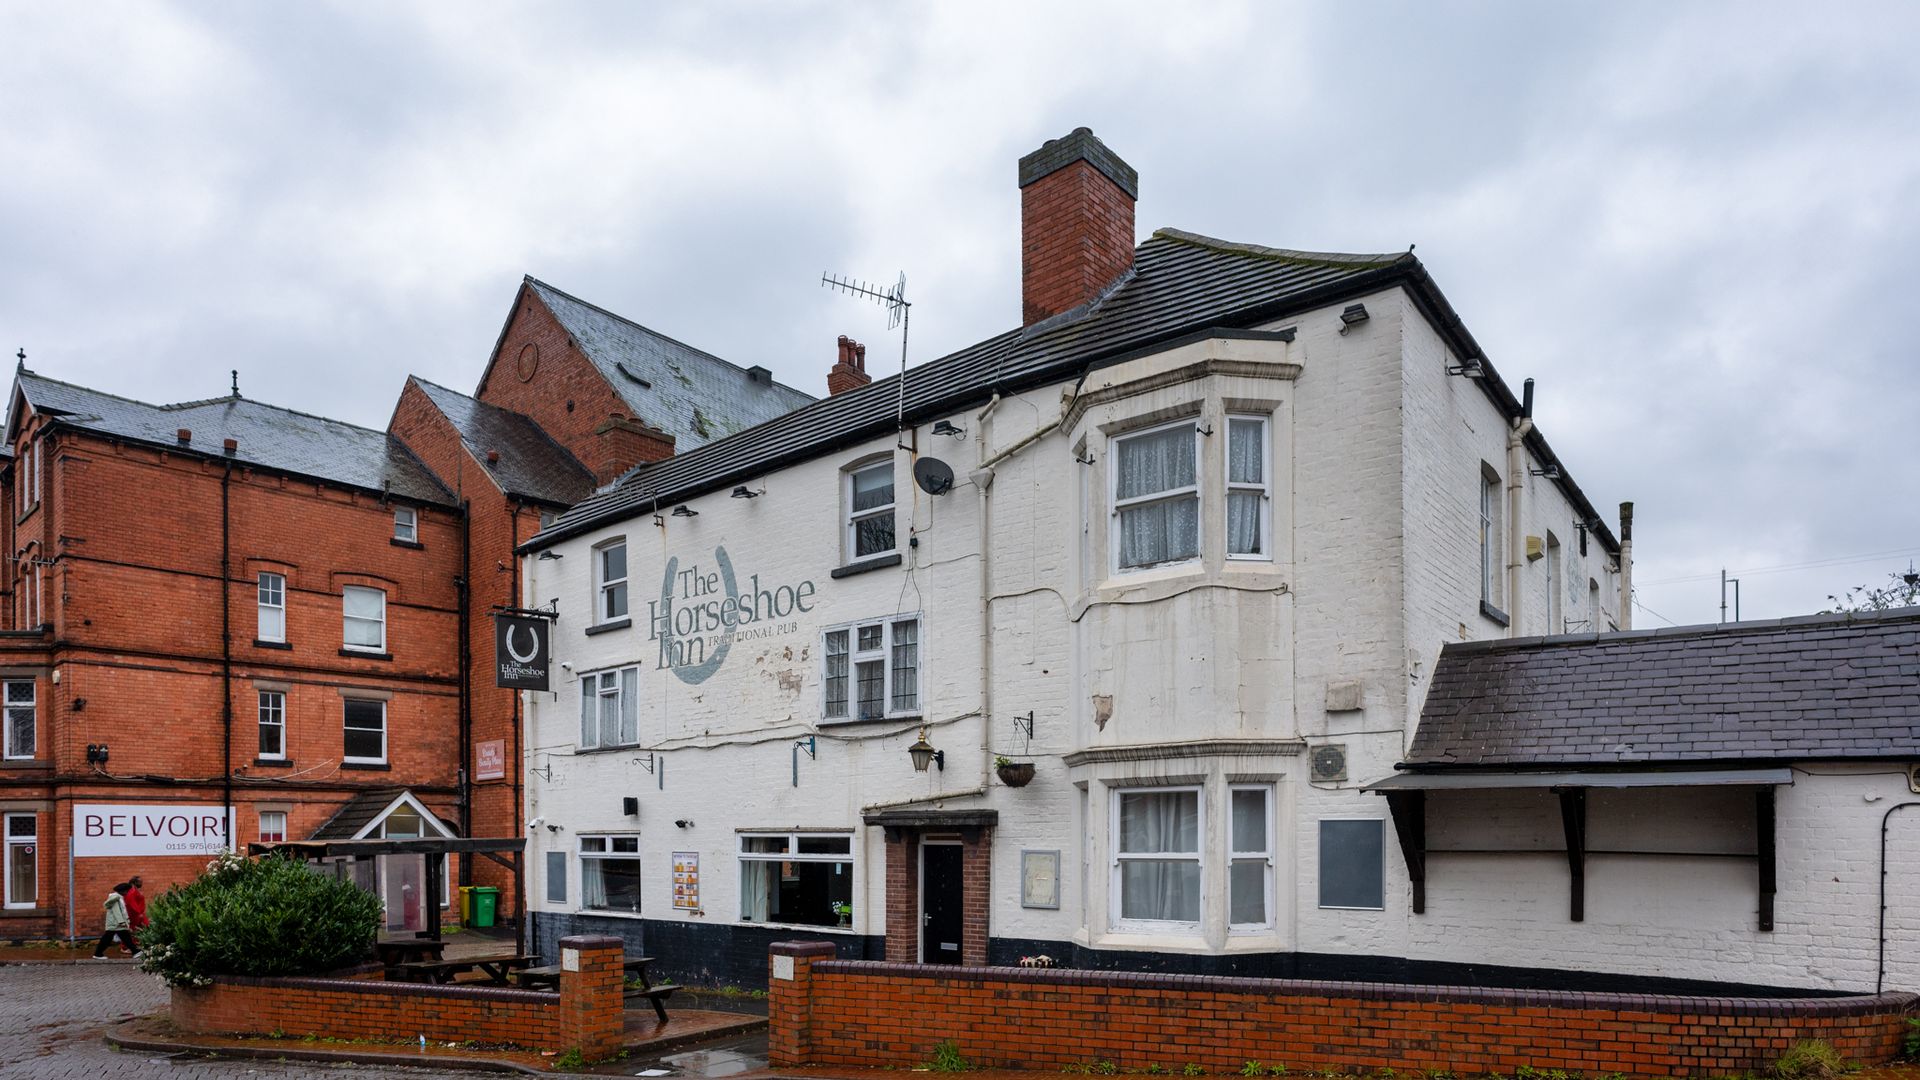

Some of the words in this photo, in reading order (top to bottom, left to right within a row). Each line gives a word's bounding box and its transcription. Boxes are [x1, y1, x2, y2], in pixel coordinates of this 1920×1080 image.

[678, 565, 719, 600] The
[648, 574, 816, 641] Horseshoe
[707, 627, 774, 647] TRADITIONAL
[777, 621, 798, 636] PUB
[655, 631, 704, 670] Inn
[501, 664, 545, 676] Horseshoe
[504, 670, 518, 679] Inn
[85, 815, 226, 837] BELVOIR!
